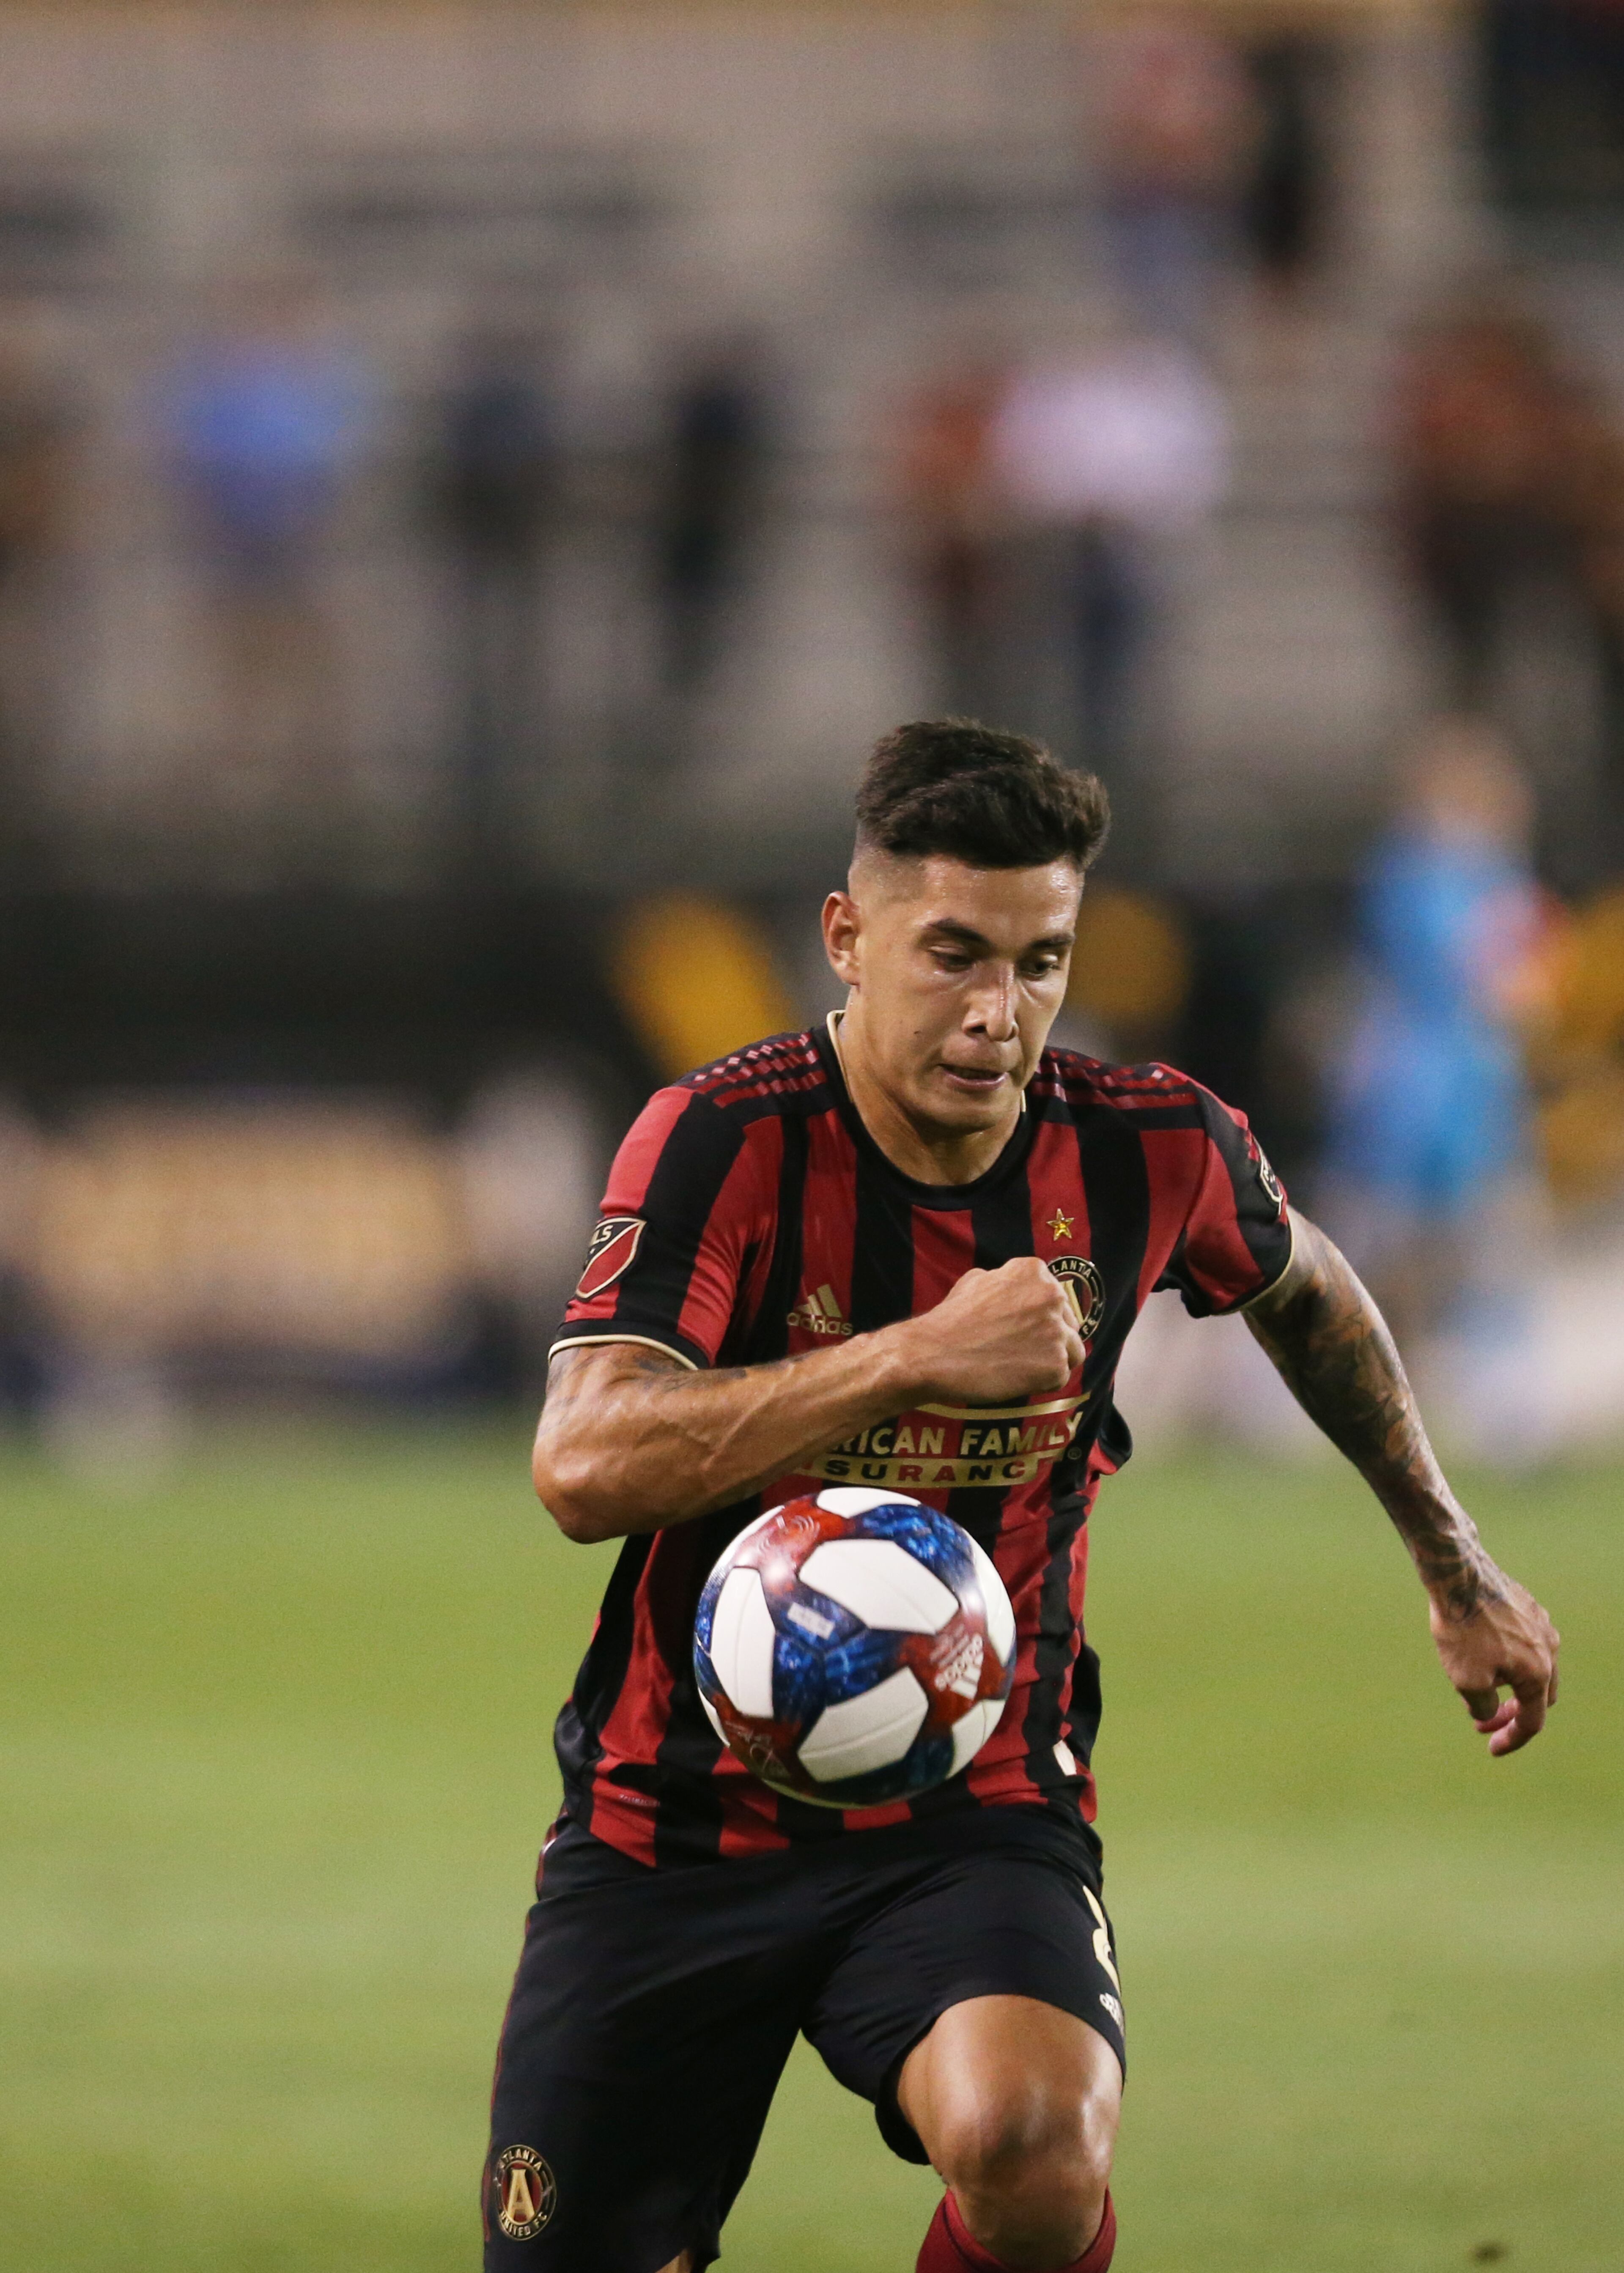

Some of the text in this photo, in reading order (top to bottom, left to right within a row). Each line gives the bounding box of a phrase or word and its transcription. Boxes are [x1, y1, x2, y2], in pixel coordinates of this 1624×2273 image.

[592, 1224, 614, 1245] LS
[1051, 1260, 1092, 1278] LANTA
[831, 1411, 1084, 1456] RICAN FAMILY
[824, 1459, 1026, 1482] SURANC
[499, 2148, 542, 2171] ATLANTA
[499, 2210, 531, 2237] UNITED
